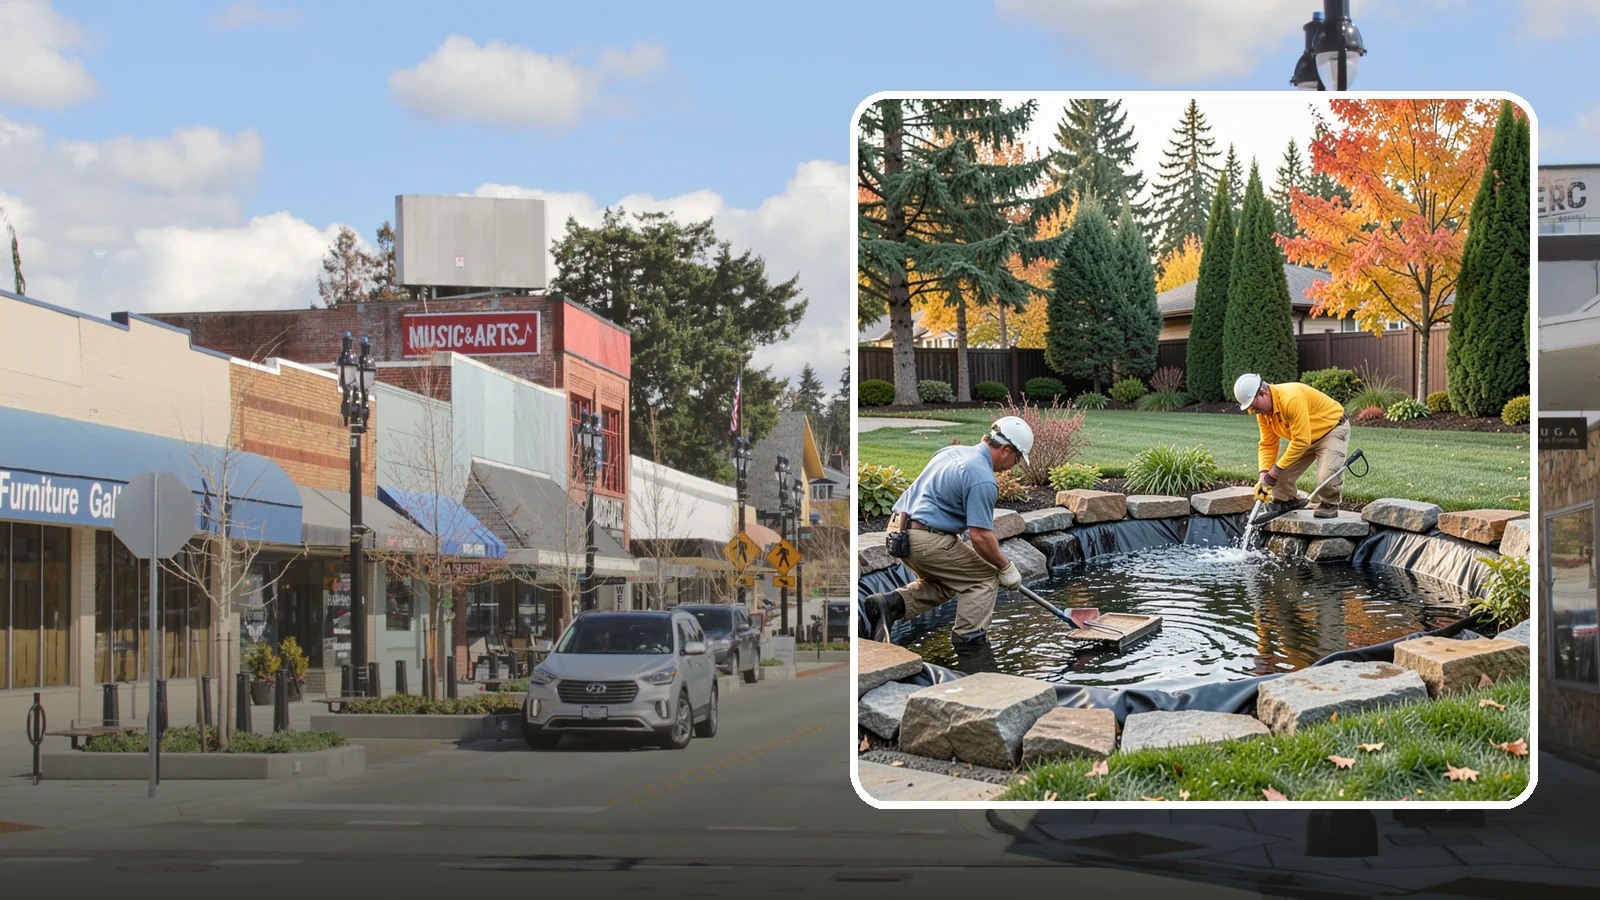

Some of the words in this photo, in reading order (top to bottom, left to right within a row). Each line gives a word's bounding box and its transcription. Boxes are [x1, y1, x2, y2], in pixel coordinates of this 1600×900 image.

[409, 323, 520, 349] MUSIC&ARTS
[1541, 427, 1577, 436] UGA
[0, 471, 79, 516] Furniture
